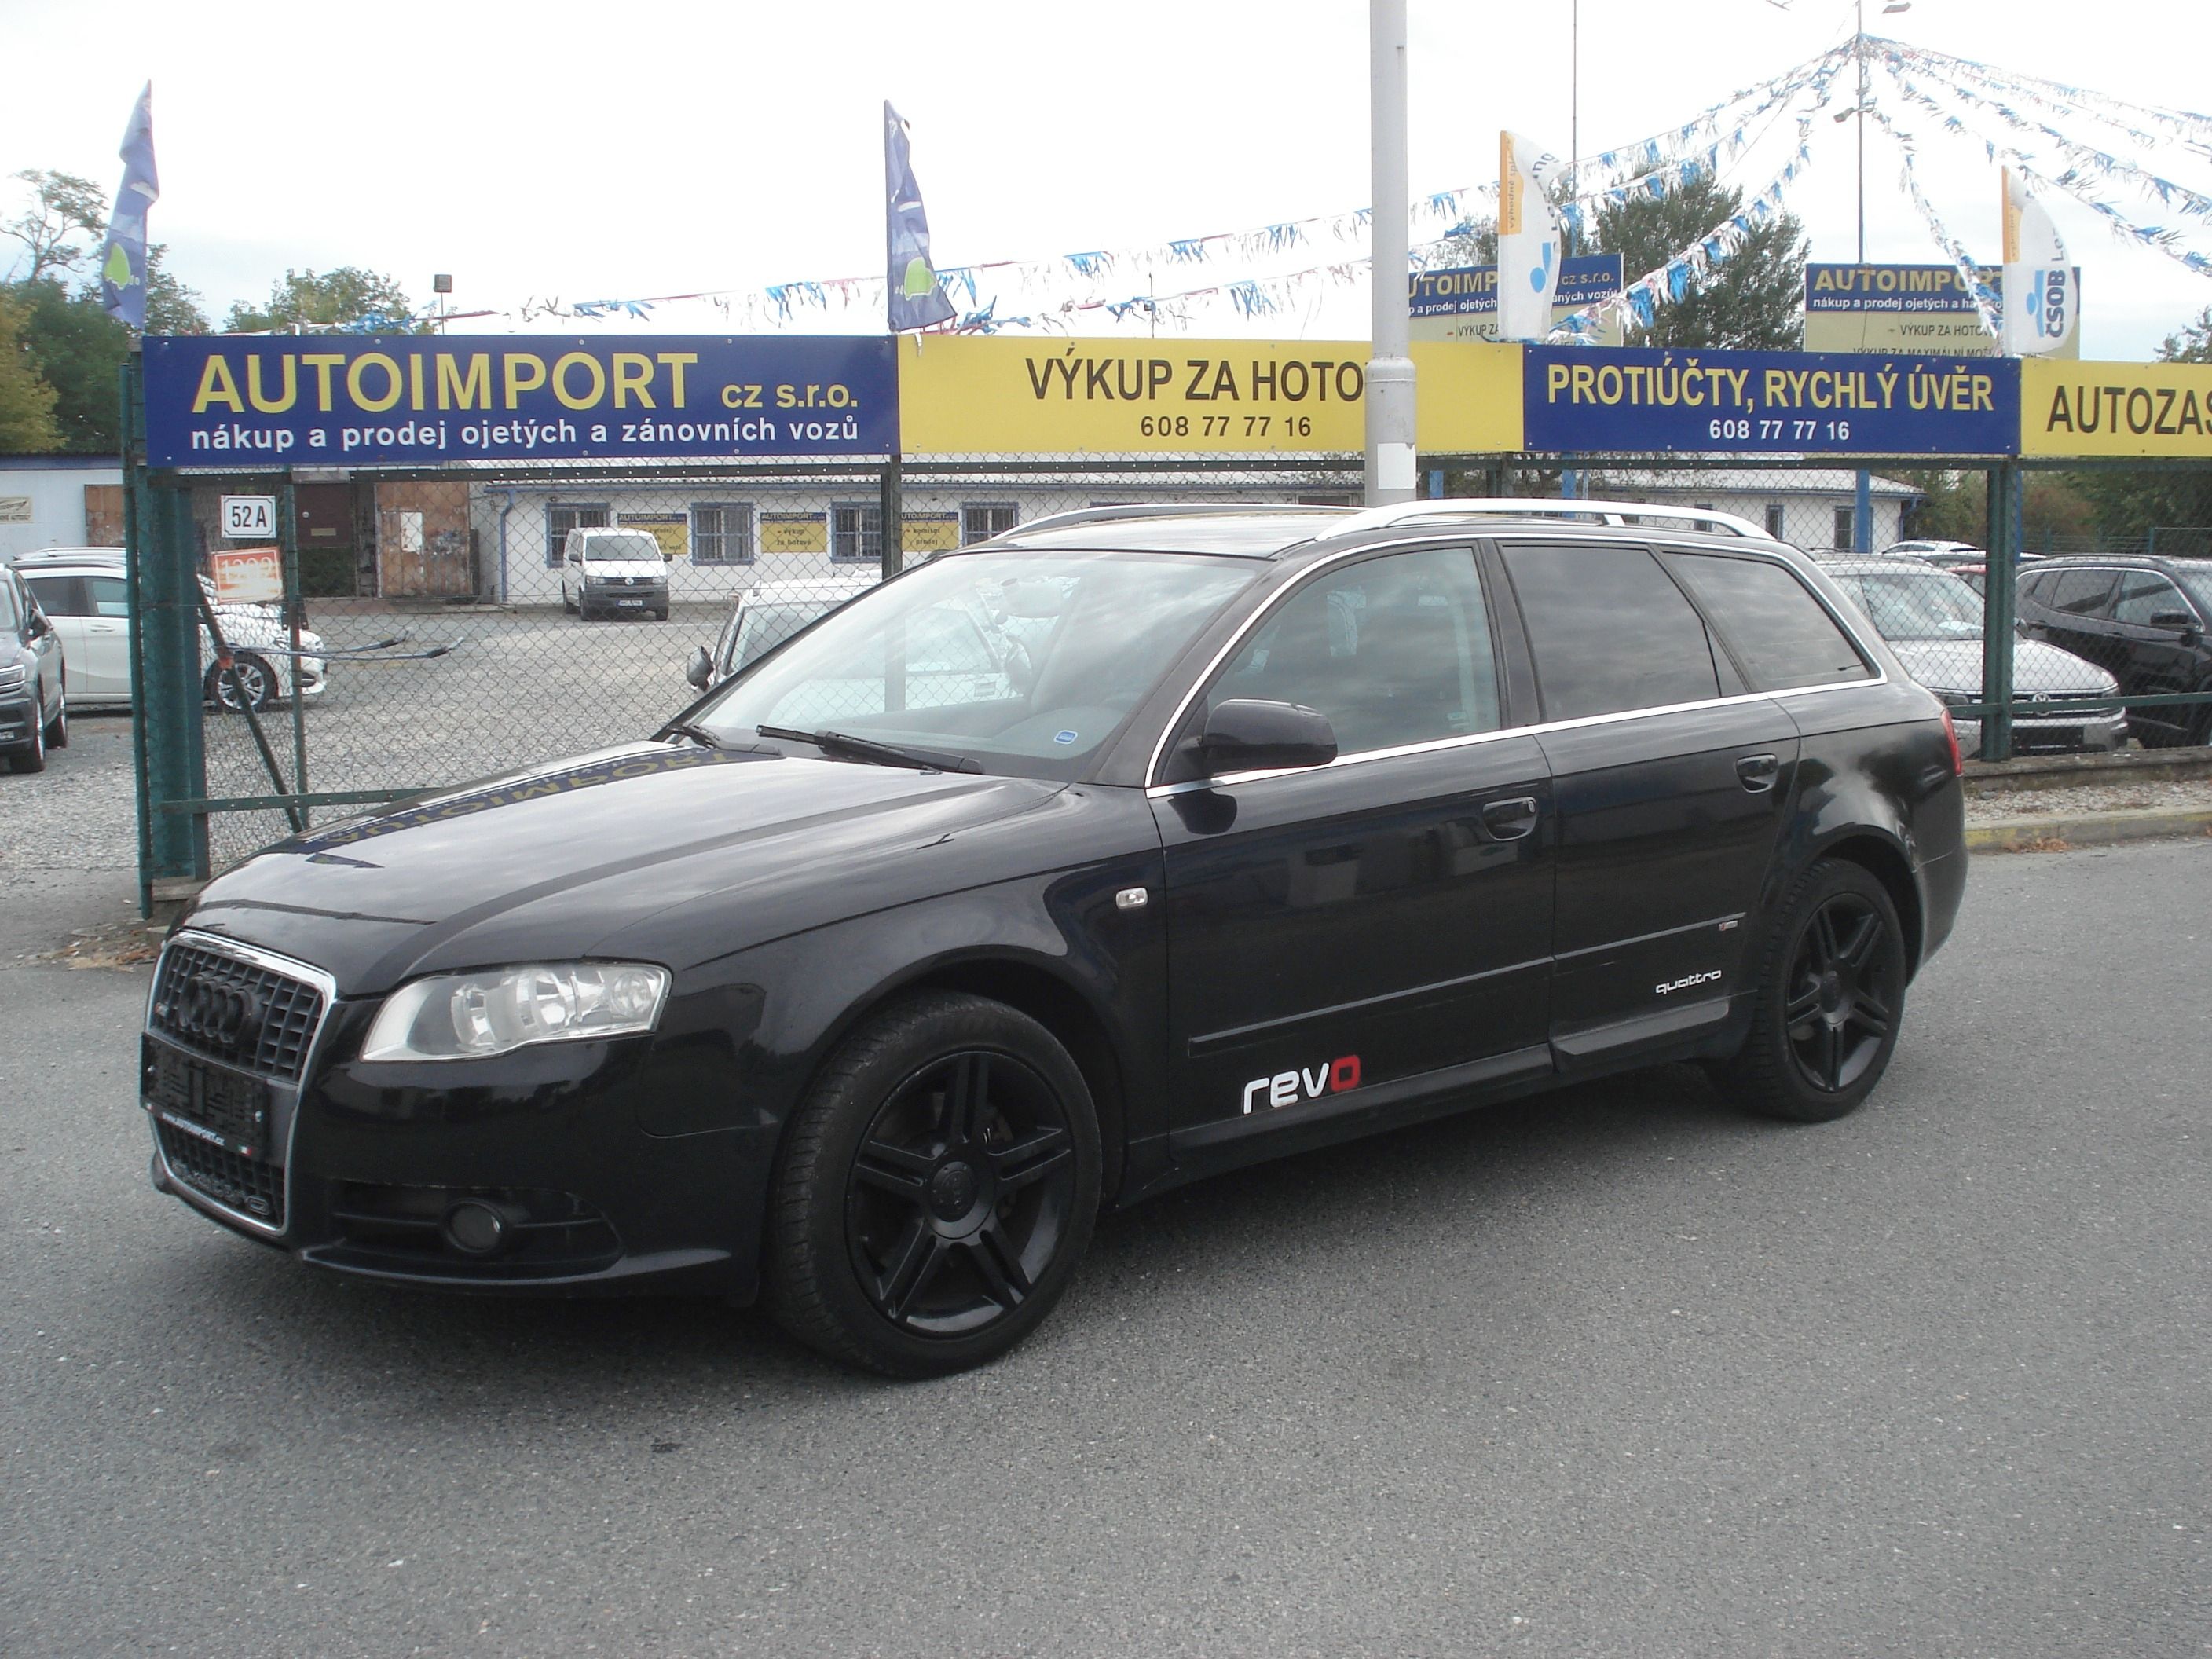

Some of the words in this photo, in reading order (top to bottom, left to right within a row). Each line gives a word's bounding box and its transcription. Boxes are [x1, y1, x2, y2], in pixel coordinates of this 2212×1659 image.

[1562, 276, 1576, 285] cz
[1580, 272, 1614, 284] s.r.o.
[1426, 300, 1456, 315] prodej
[1459, 298, 1497, 313] ojetých
[1813, 297, 1850, 309] nákup
[1864, 298, 1902, 310] prodej
[1906, 298, 1948, 309] ojetých
[2045, 270, 2066, 338] ČSOB
[1459, 323, 1487, 336] VÝKUP
[1901, 322, 1935, 336] VÝKUP
[1938, 325, 1951, 336] ZA
[1954, 325, 1992, 336] HOTO
[192, 352, 698, 414] AUTOIMPORT
[721, 384, 763, 408] cz
[776, 384, 859, 408] s.r.o.
[1025, 348, 1173, 401] VÝKUP
[1185, 360, 1240, 401] ZA
[1252, 361, 1366, 402] HOTO
[1548, 358, 1754, 414] PROTIÚČTY,
[1766, 364, 1899, 411] RYCHLÝ
[1908, 364, 1994, 412] ÚVĚR
[192, 423, 294, 452] nákup
[309, 430, 327, 448] a
[342, 420, 446, 451] prodej
[461, 419, 577, 448] ojetých
[591, 425, 608, 443] a
[621, 416, 776, 442] zánovních
[789, 415, 859, 440] vozů
[1140, 416, 1189, 437] 608
[1202, 416, 1231, 437] 77
[1243, 416, 1272, 437] 77
[1284, 416, 1312, 438] 16
[1709, 419, 1750, 440] 608
[1760, 419, 1783, 440] 77
[1793, 420, 1817, 441] 77
[1826, 420, 1851, 441] 16
[232, 505, 251, 528] 52
[255, 505, 267, 528] A
[1655, 969, 1722, 995] quattro
[1243, 1054, 1361, 1115] revo
